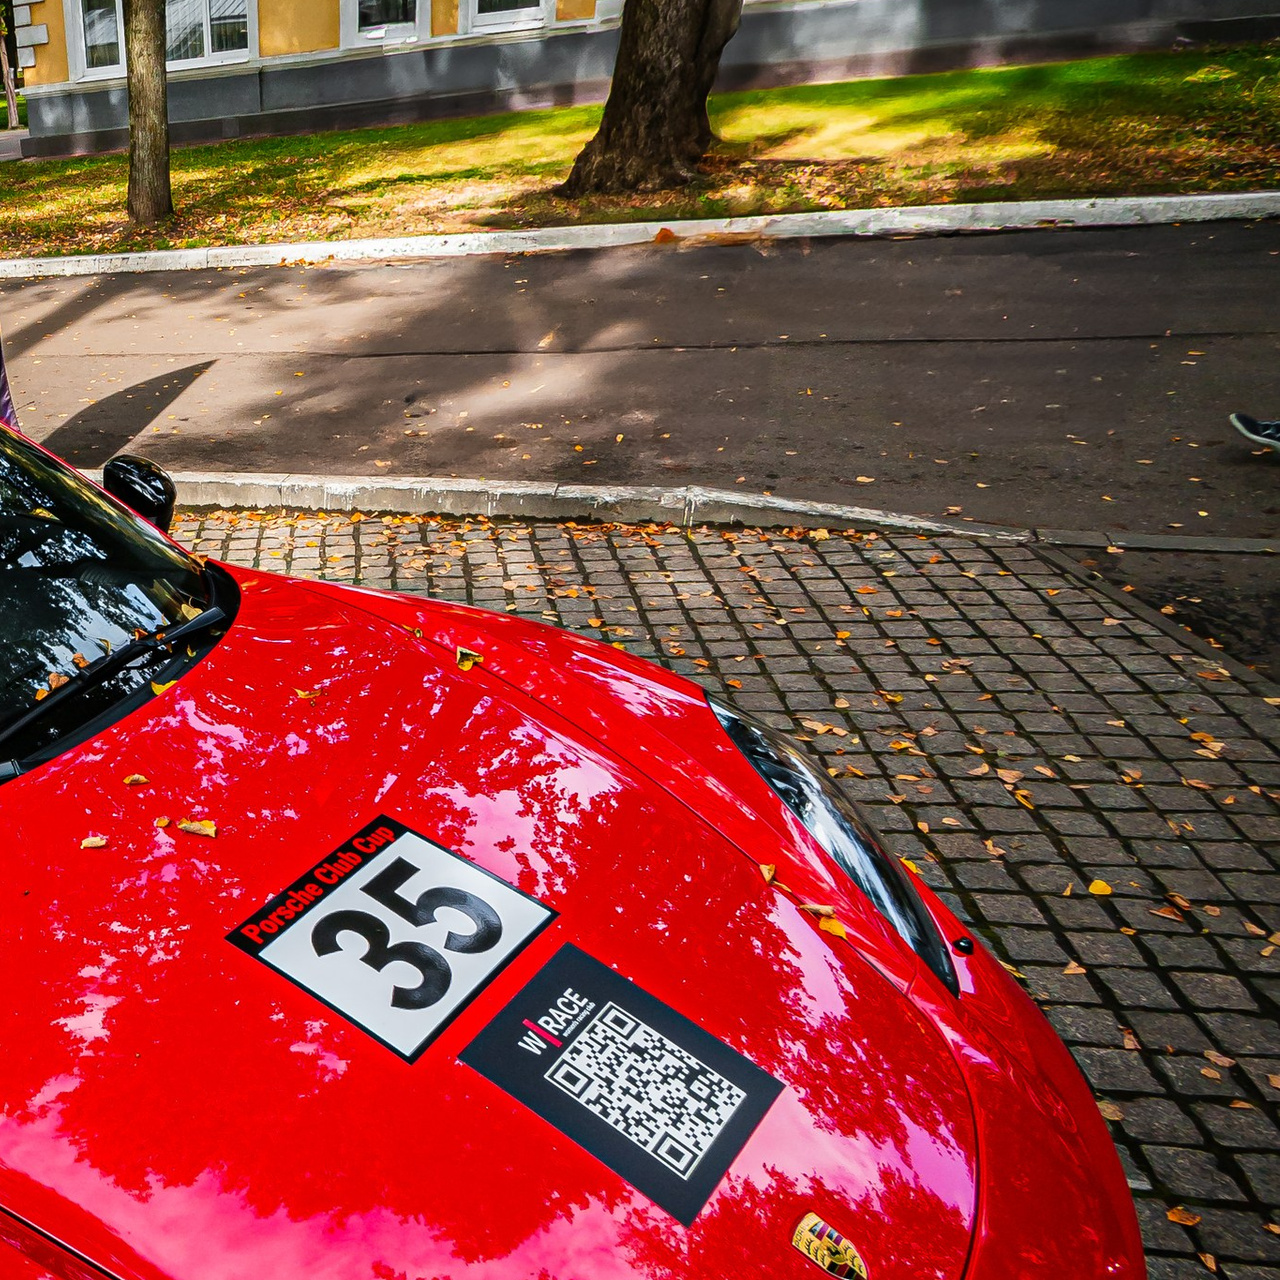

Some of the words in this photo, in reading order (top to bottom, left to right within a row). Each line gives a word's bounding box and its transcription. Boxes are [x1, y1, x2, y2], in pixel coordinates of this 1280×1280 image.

[240, 883, 323, 945] Porsche
[314, 851, 362, 885] Club
[352, 826, 396, 854] Cup
[311, 856, 503, 1010] 35
[537, 987, 589, 1036] RACE
